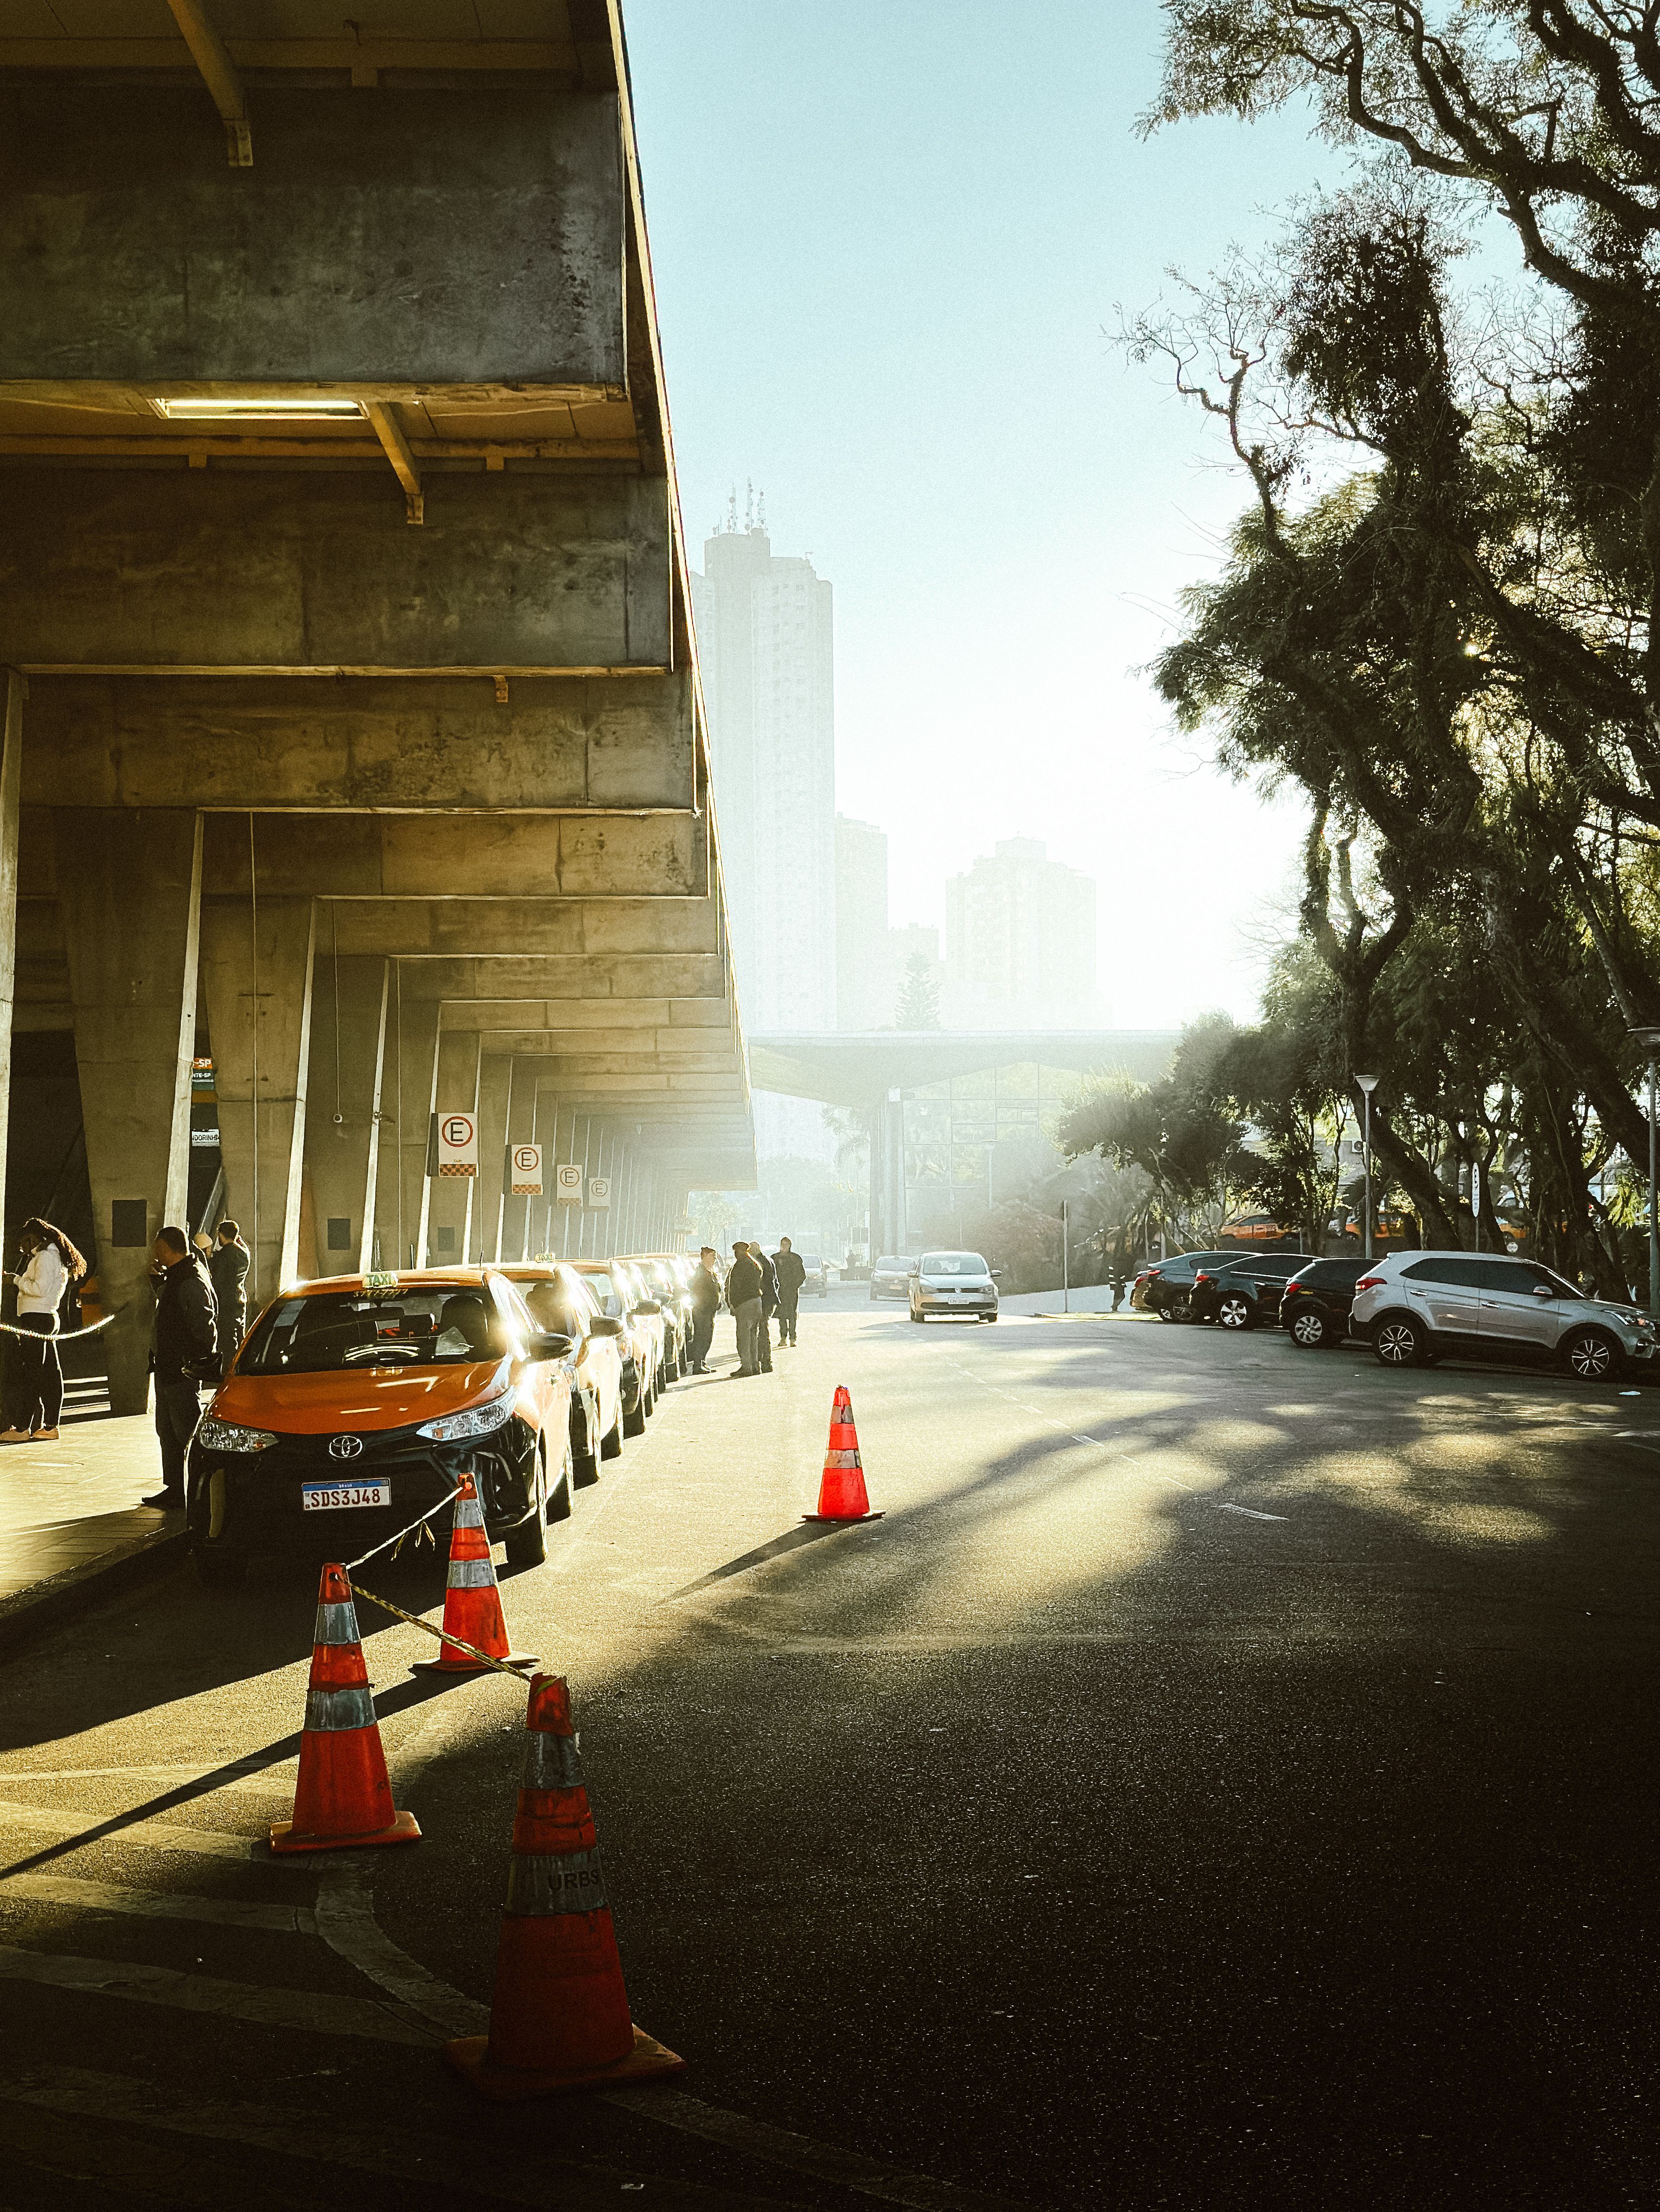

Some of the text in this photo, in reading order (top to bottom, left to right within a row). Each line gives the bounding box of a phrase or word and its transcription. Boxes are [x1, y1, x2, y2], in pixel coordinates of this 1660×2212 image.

[451, 1122, 464, 1141] E
[521, 1151, 532, 1167] E
[565, 1171, 574, 1183] E
[596, 1183, 603, 1194] E
[367, 1274, 393, 1287] TAXI
[311, 1488, 380, 1507] SDS3J48
[548, 1869, 600, 1890] URBS
